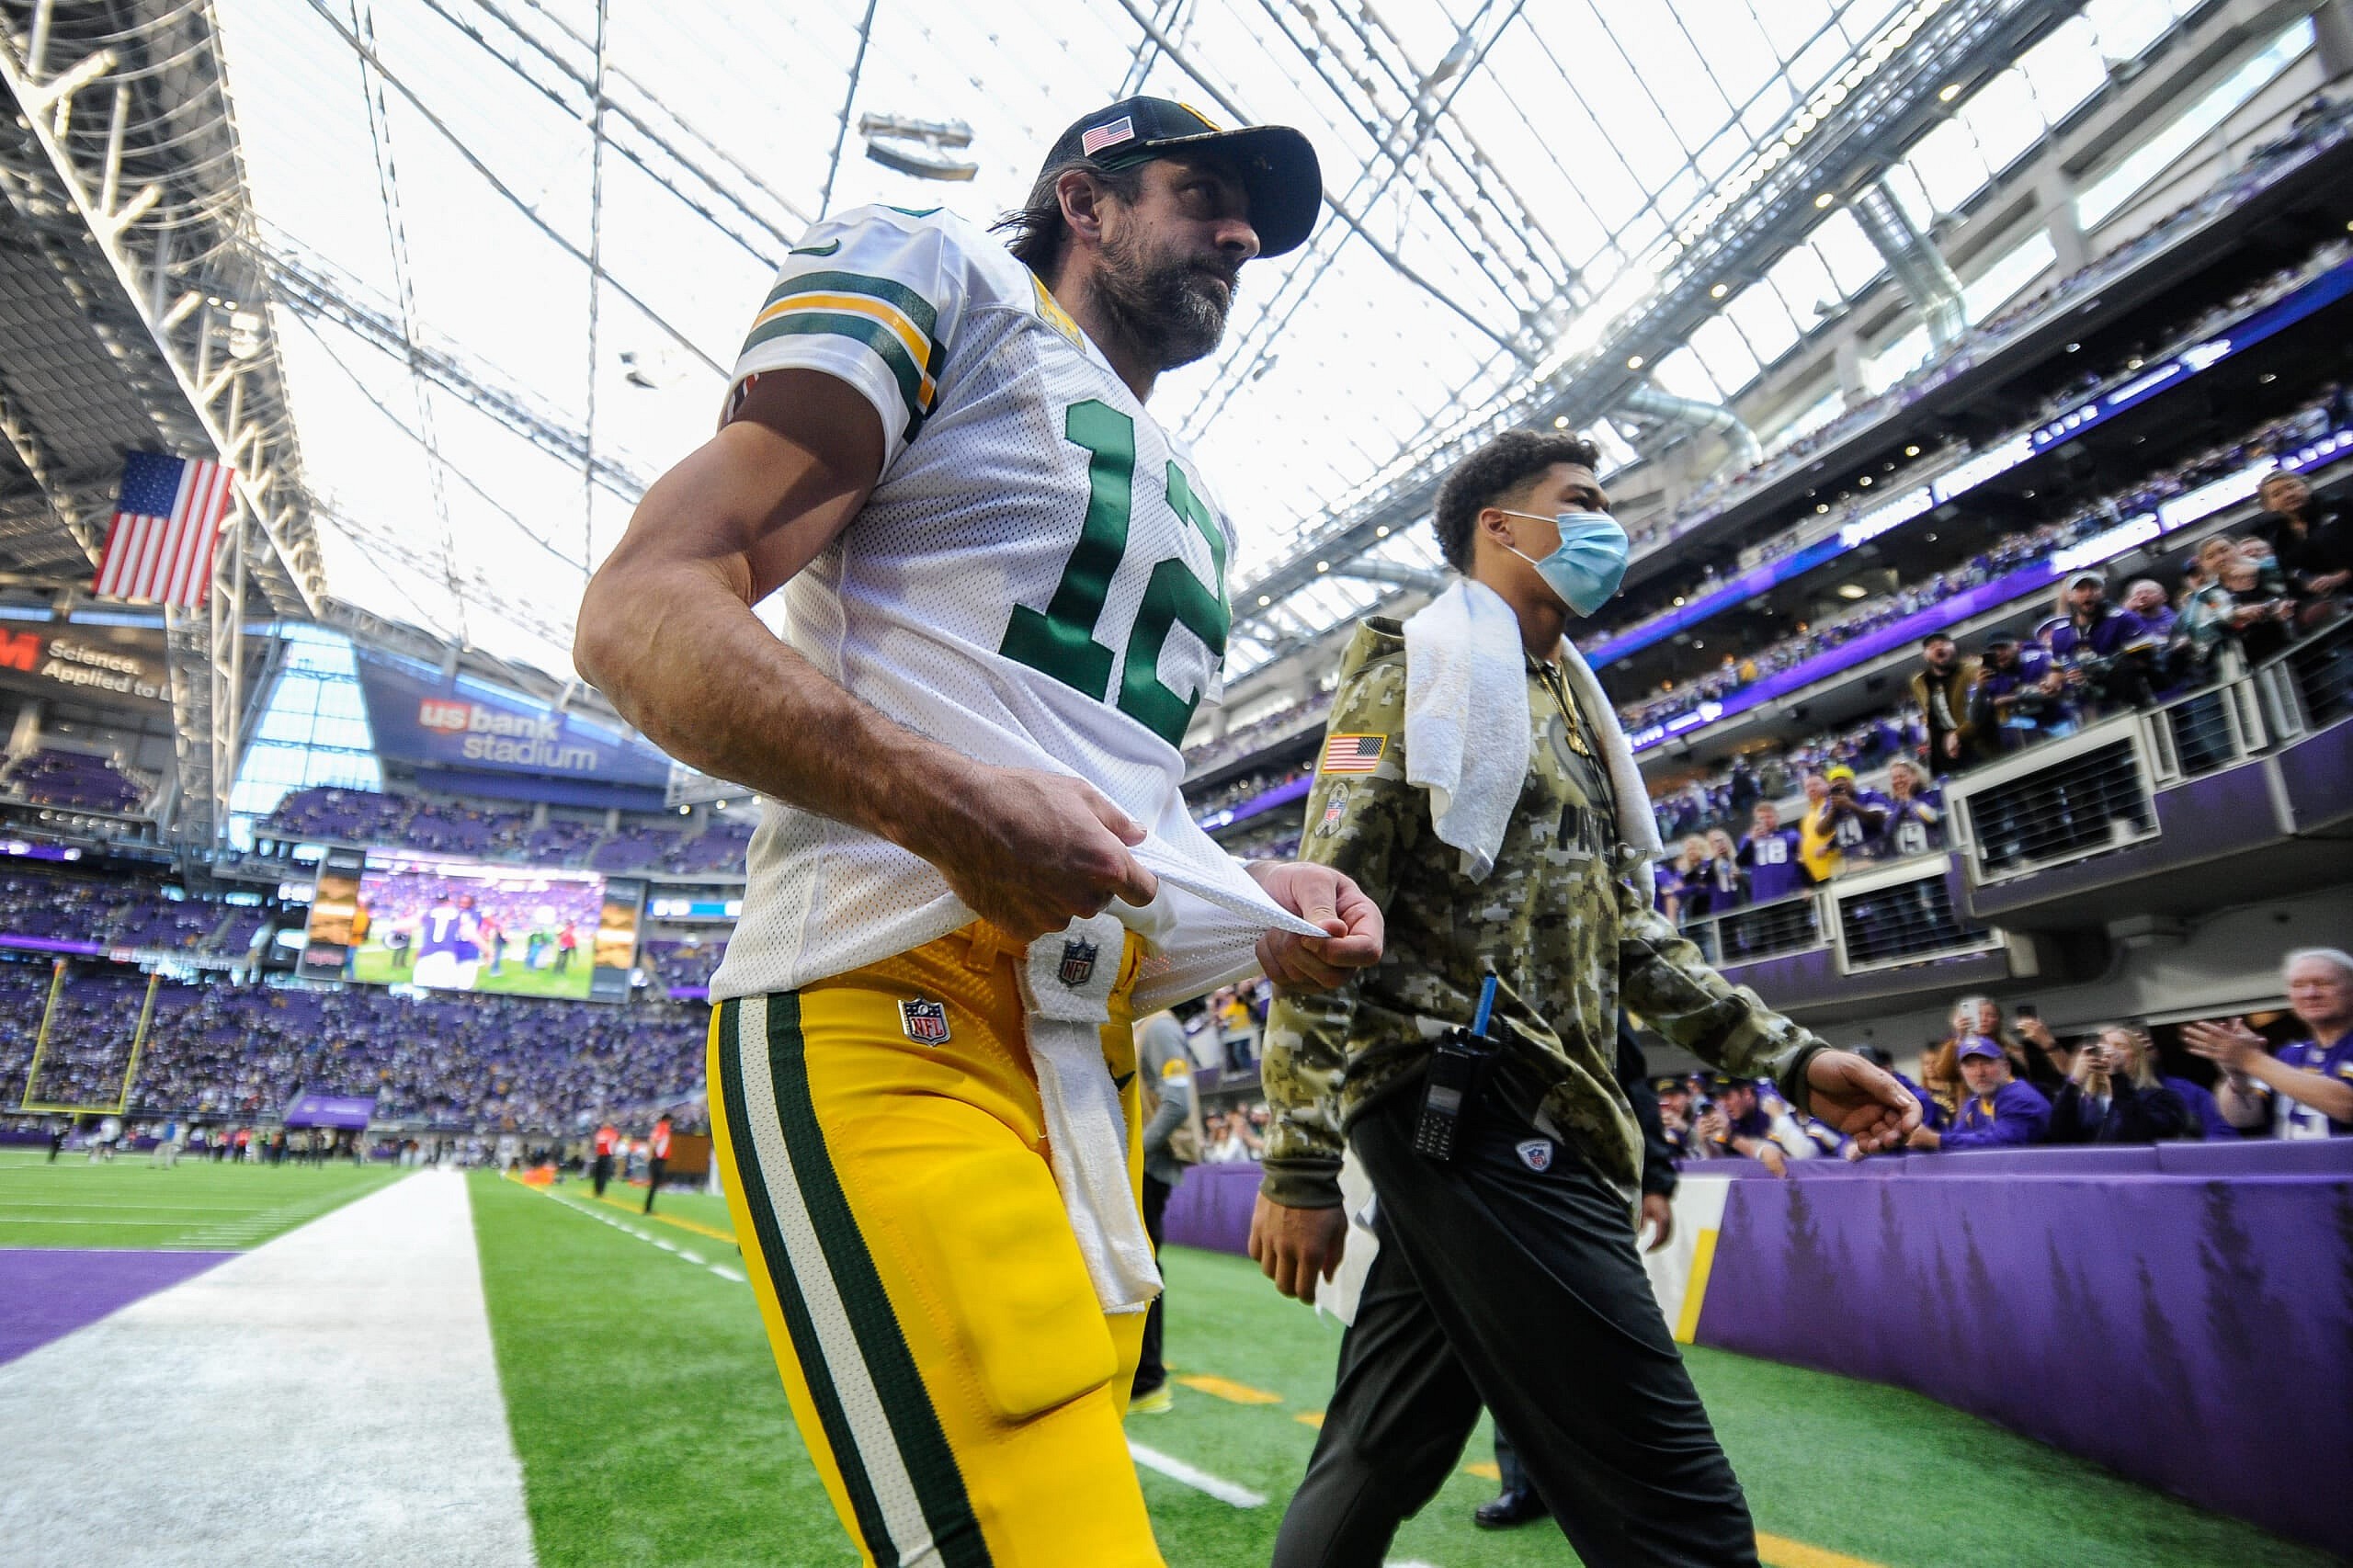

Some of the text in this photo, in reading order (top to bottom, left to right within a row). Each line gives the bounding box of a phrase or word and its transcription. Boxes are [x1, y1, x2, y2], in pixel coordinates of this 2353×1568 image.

[999, 399, 1232, 750] 12
[48, 639, 142, 676] Science.
[41, 659, 133, 693] Applied
[134, 678, 155, 699] to
[419, 704, 561, 741] us bank
[462, 733, 597, 771] stadium
[1063, 960, 1089, 982] NFL
[910, 1017, 944, 1039] NFL
